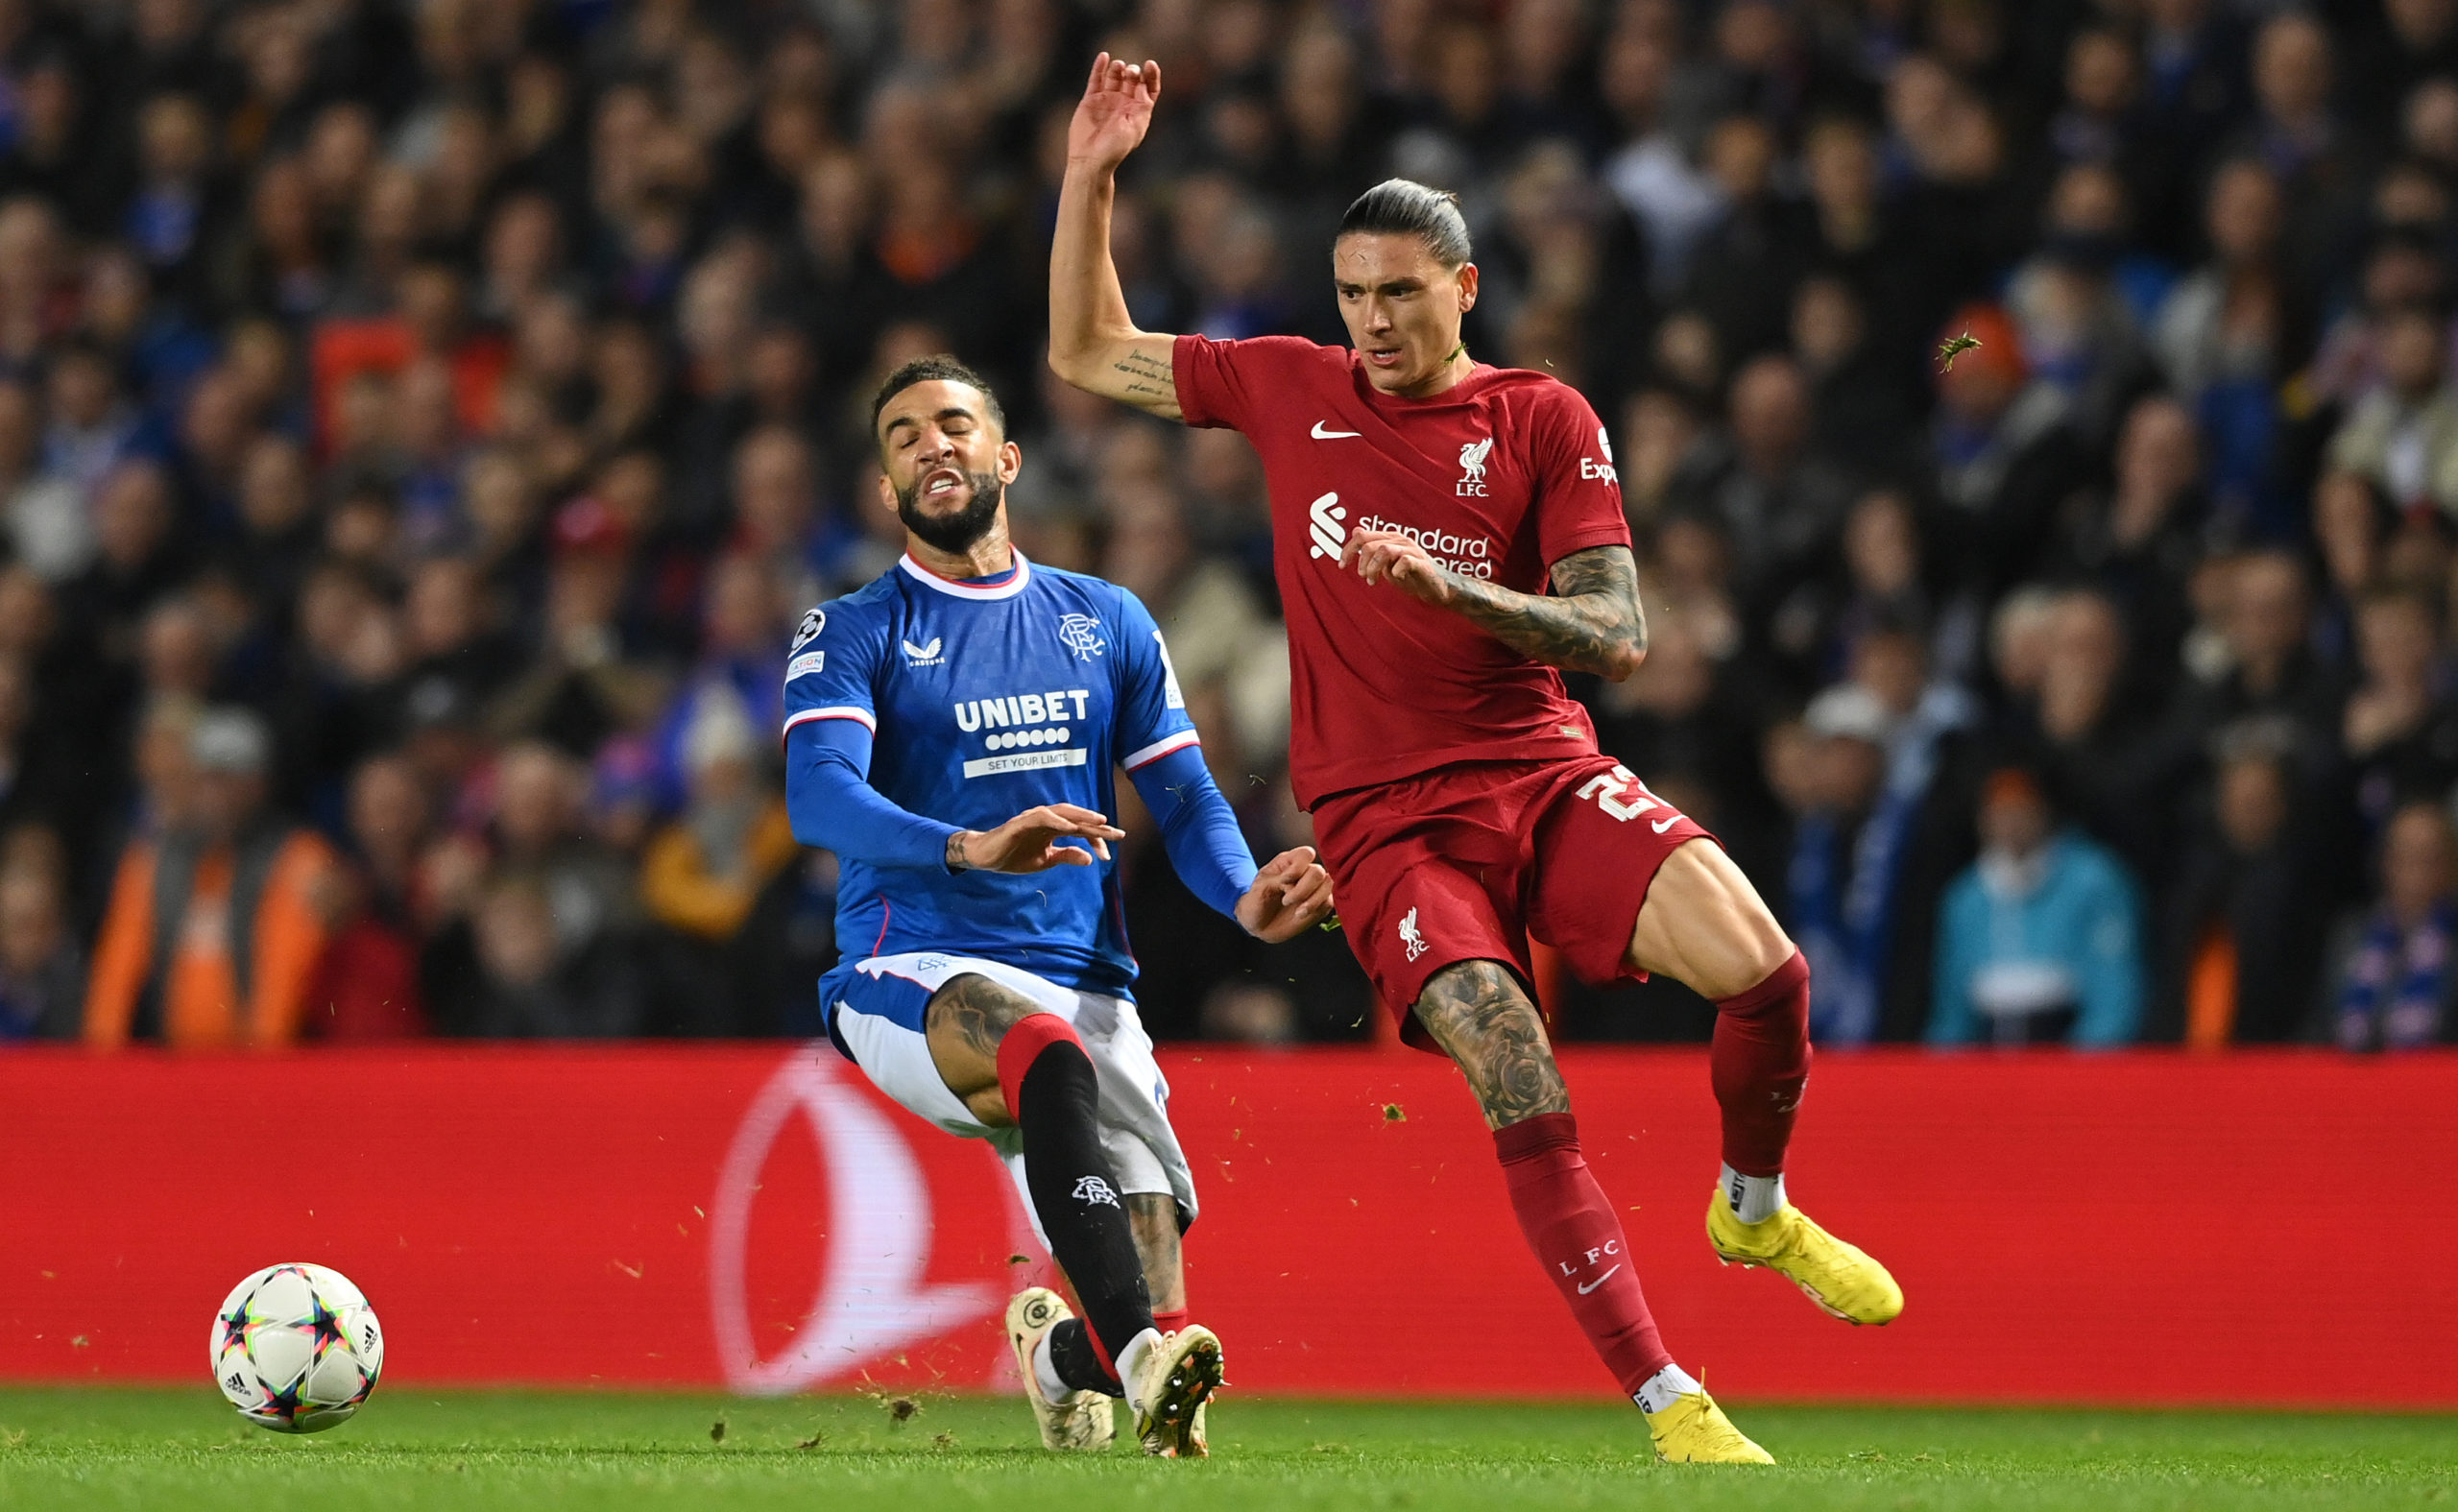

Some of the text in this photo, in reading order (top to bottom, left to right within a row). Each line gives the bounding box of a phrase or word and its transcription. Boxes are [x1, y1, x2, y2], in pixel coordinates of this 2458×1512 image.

[1359, 515, 1489, 559] standard
[954, 689, 1089, 732] UNIBET
[988, 753, 1069, 771] SET YOUR LIMITS
